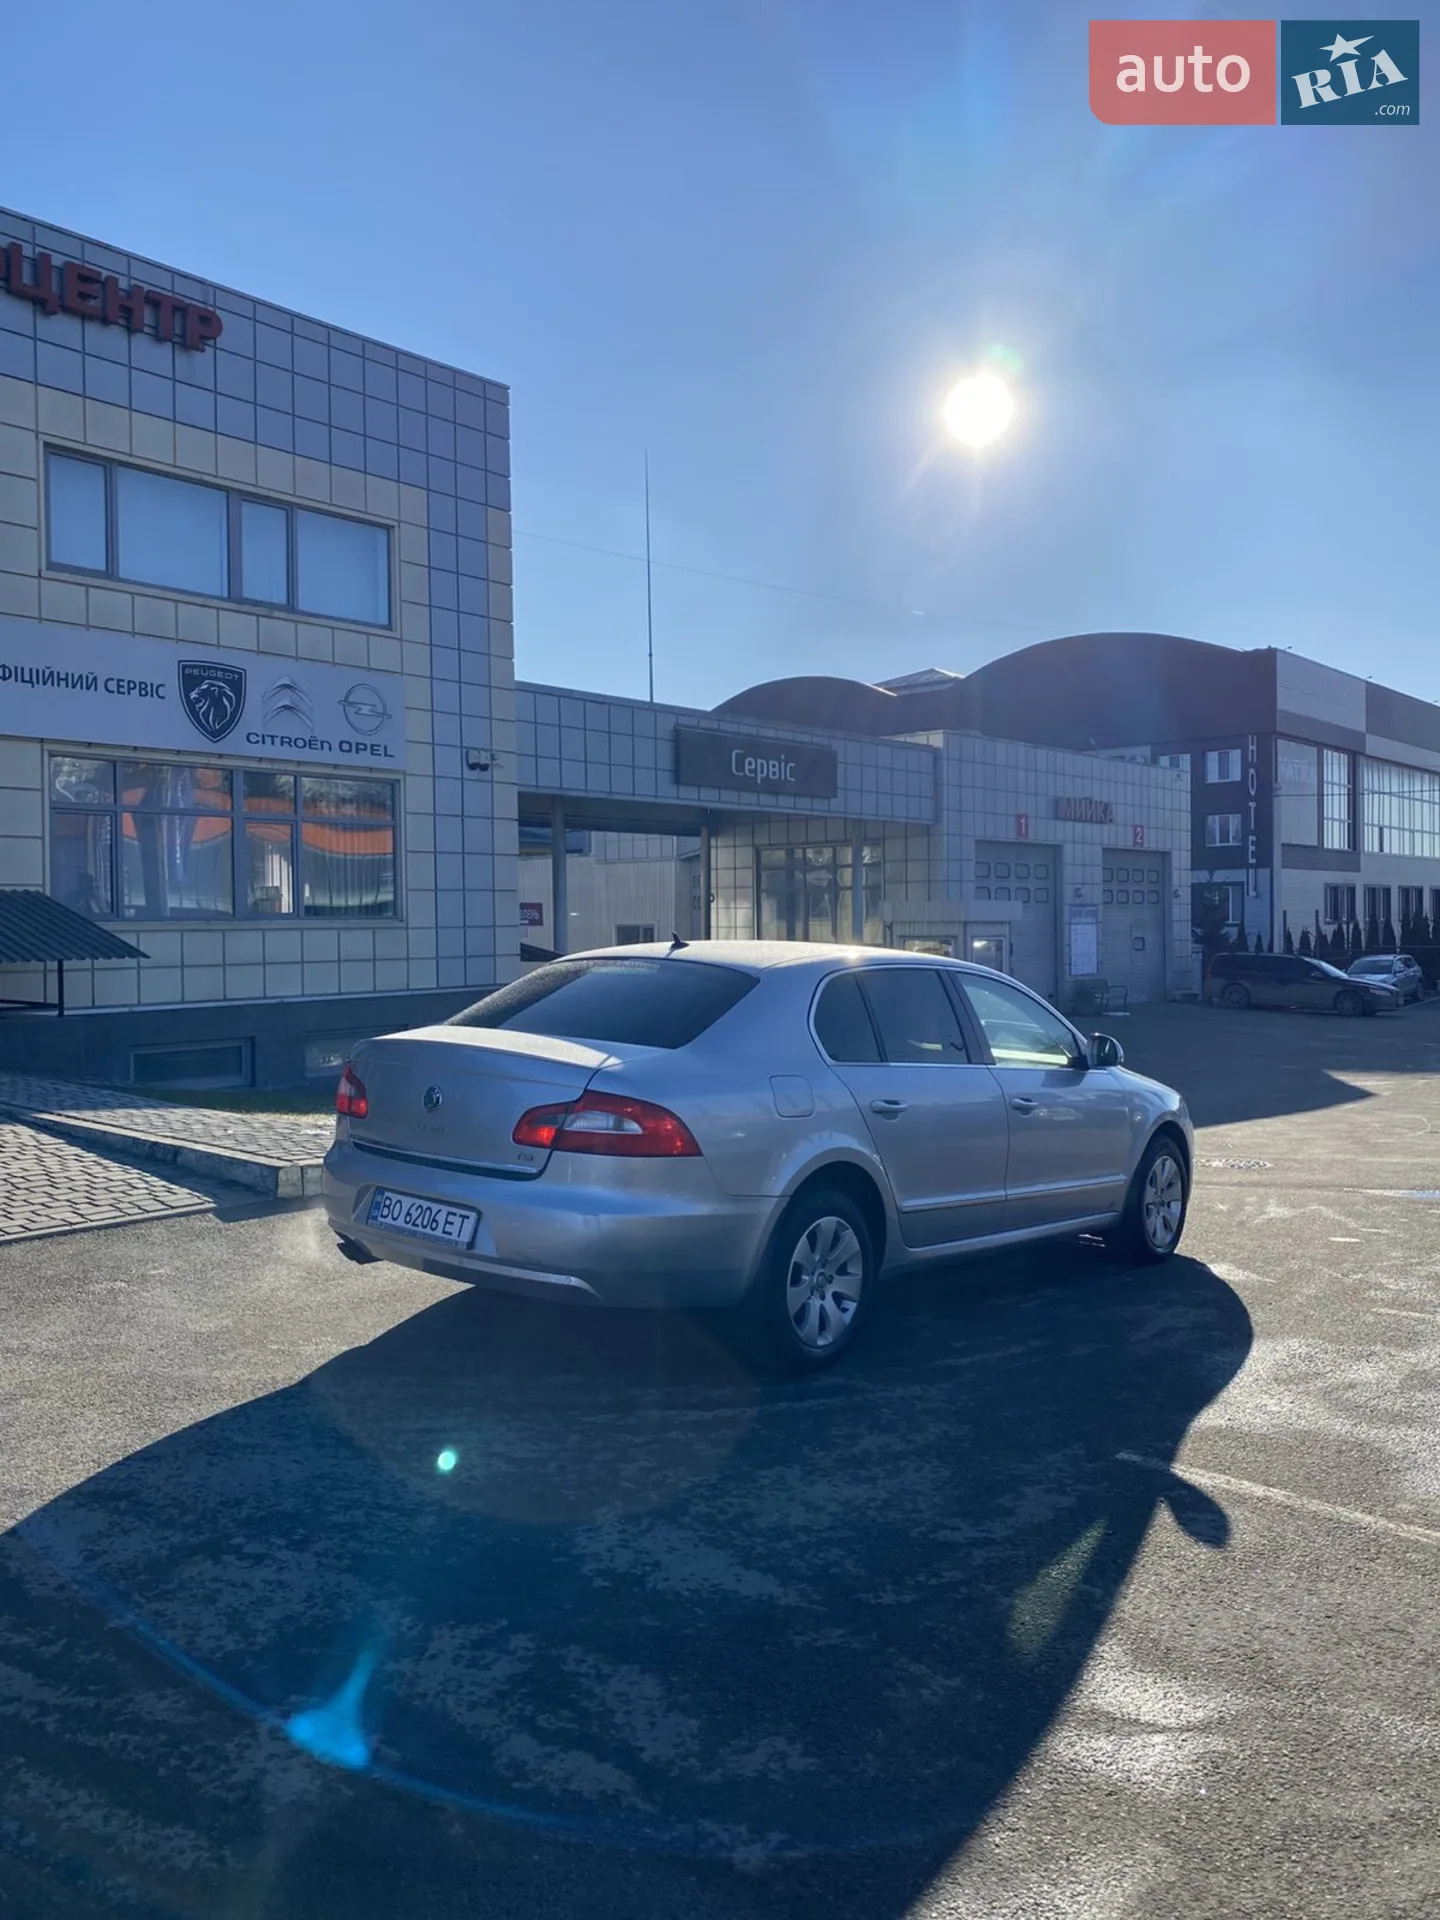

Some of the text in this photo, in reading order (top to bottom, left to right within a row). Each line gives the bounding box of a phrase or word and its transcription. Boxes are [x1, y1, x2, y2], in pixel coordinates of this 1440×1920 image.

[0, 241, 223, 352] ЦЕНТР
[104, 677, 166, 699] СЕРВІС
[185, 667, 240, 681] PEUGEOT
[338, 740, 395, 758] OPEL
[731, 749, 796, 784] Сервіс
[1247, 734, 1258, 898] HOTEL
[1135, 828, 1143, 844] 2
[380, 1196, 404, 1222] BO
[403, 1202, 442, 1232] 6206
[442, 1211, 470, 1238] ET
